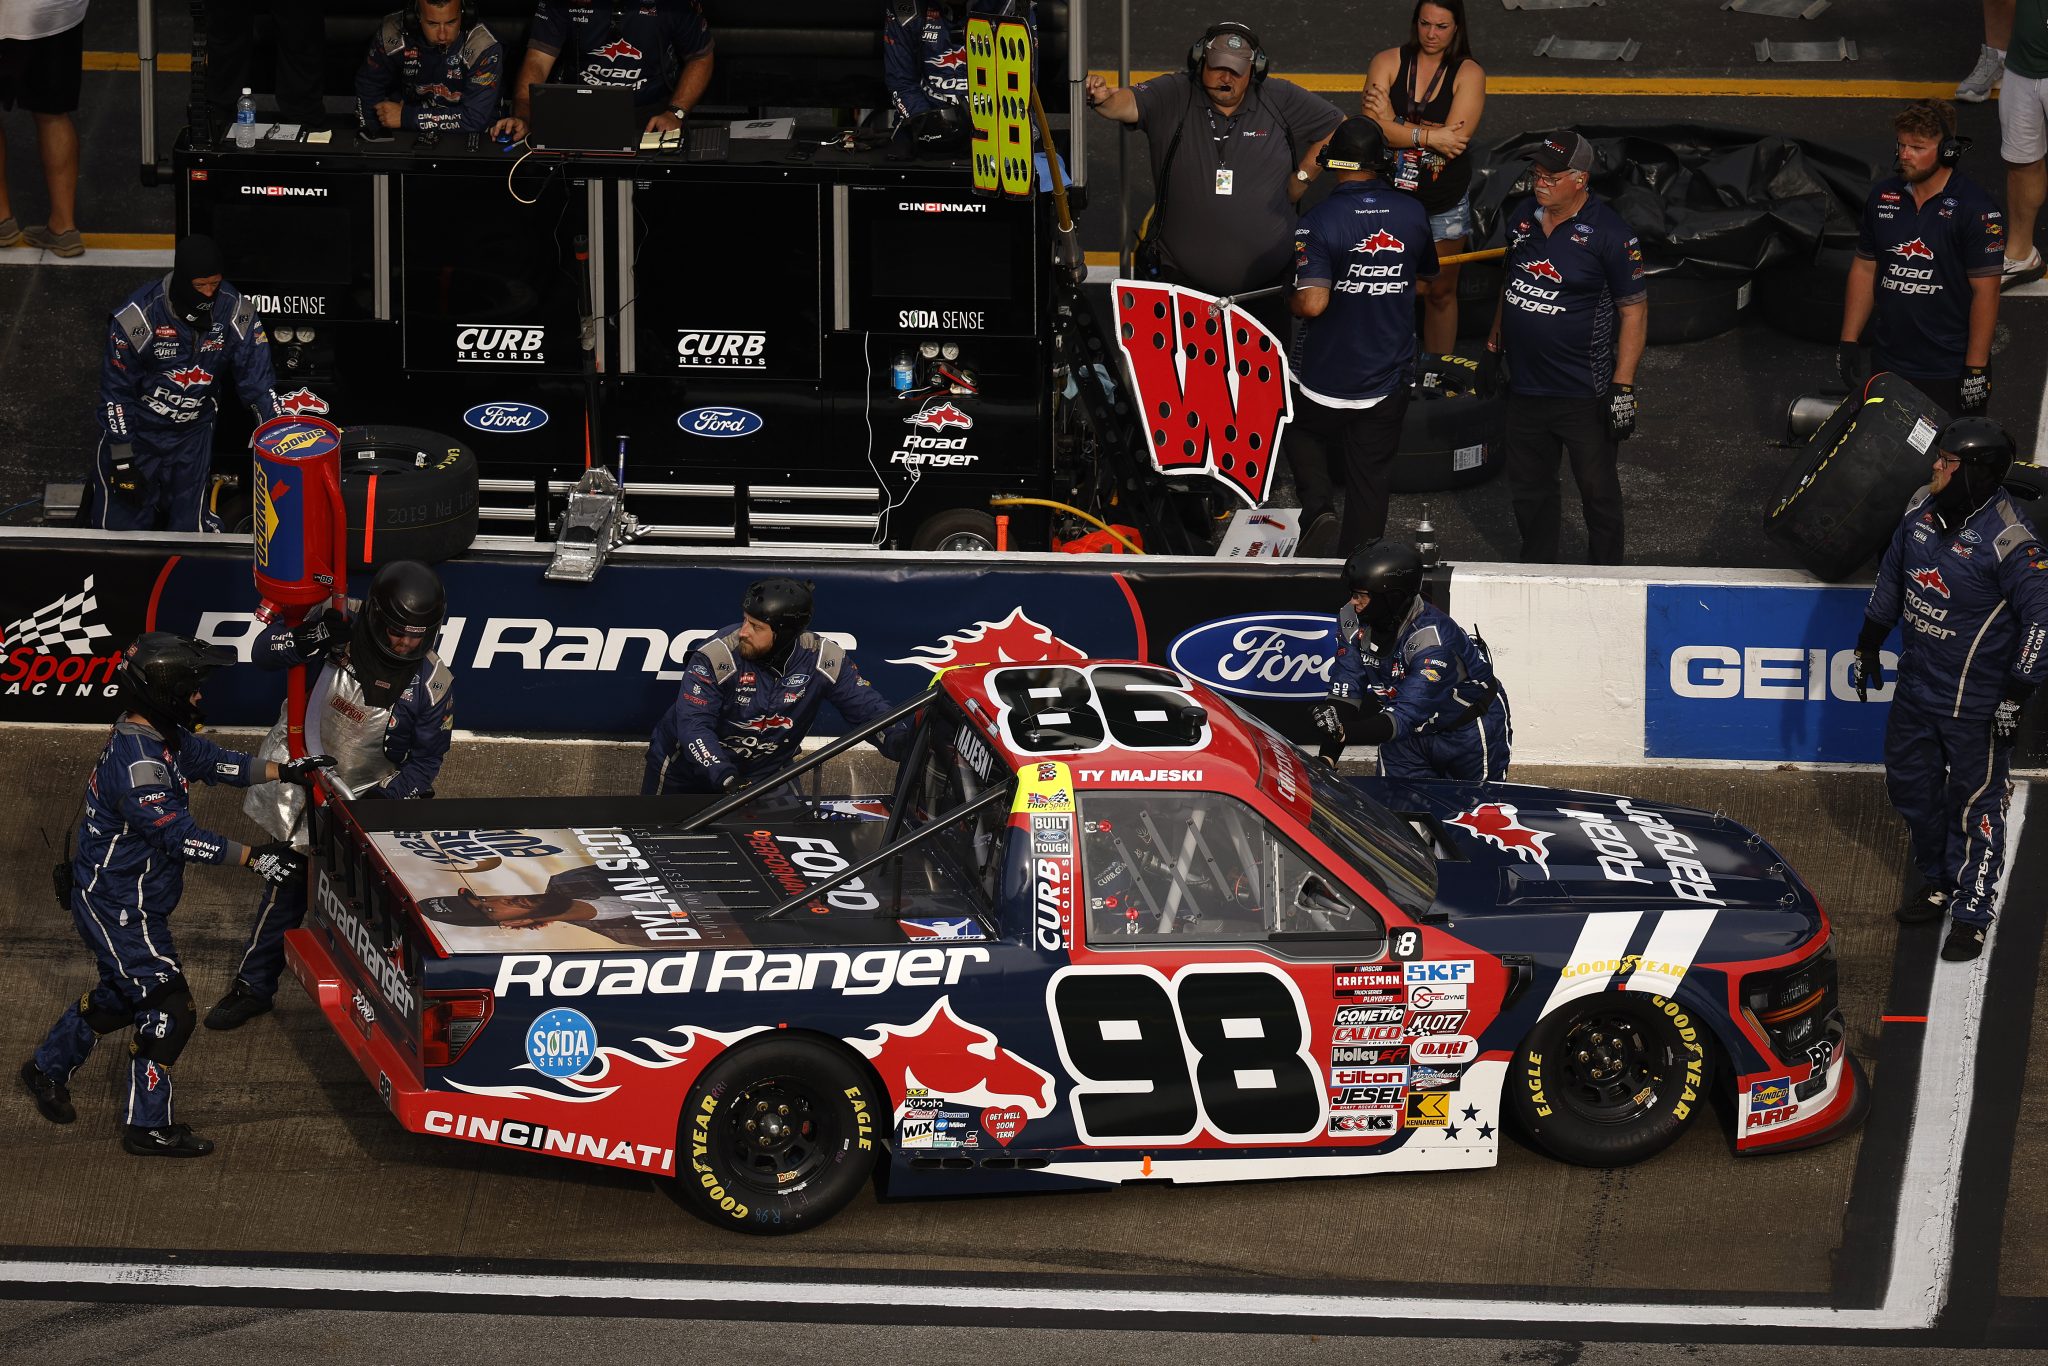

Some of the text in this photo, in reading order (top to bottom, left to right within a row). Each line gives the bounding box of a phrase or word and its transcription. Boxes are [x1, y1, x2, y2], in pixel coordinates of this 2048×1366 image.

[586, 64, 642, 80] Road
[966, 17, 1033, 196] 98
[240, 185, 328, 197] CINCINNATI
[898, 202, 986, 213] CINCINNATI
[1347, 264, 1404, 277] Road
[1888, 263, 1934, 280] Road
[1333, 279, 1409, 296] Ranger
[1511, 278, 1560, 300] Road
[1881, 276, 1944, 295] Ranger
[283, 296, 326, 315] SENSE
[1505, 289, 1567, 316] Ranger
[898, 310, 985, 330] SODA SENSE
[456, 328, 544, 352] CURB
[677, 333, 767, 357] CURB
[458, 351, 545, 360] RECORDS
[679, 357, 767, 366] RECORDS
[480, 405, 531, 428] Ford
[694, 410, 746, 433] Ford
[273, 429, 323, 456] SUNOCO
[902, 434, 967, 450] Road
[890, 450, 979, 467] Ranger
[1905, 587, 1949, 622] Road
[2023, 629, 2047, 675] CURB.COM
[0, 647, 122, 691] Sport
[1669, 645, 1899, 702] GEIC
[3, 682, 120, 698] ACING
[333, 697, 366, 723] SIMPSON
[1078, 769, 1203, 782] TY MAJESKI
[1035, 817, 1069, 830] BUILT
[1035, 842, 1069, 853] TOUGH
[1556, 806, 1654, 885] Road
[1615, 799, 1727, 907] Ranger
[607, 876, 702, 941] DYLAN
[1037, 858, 1061, 951] CURB
[1061, 859, 1070, 949] RECORDS
[316, 868, 415, 1019] Road Ranger
[493, 946, 991, 998] Road Ranger
[1406, 963, 1471, 982] SKF
[1561, 957, 1688, 979] GOODYEAR
[1336, 975, 1400, 987] CRAFTSMAN
[1362, 995, 1394, 1003] PLAYOFFS
[1336, 1008, 1404, 1022] COMETIC
[1411, 1014, 1463, 1030] KLOTZ
[532, 1026, 590, 1059] SODA
[1333, 1026, 1402, 1041] CALICO
[538, 1056, 582, 1068] SENSE
[1046, 962, 1330, 1147] 98
[1333, 1047, 1409, 1065] Holley EFI
[1652, 994, 1704, 1121] GOODYEAR
[1335, 1070, 1403, 1084] tilton
[1527, 1050, 1553, 1118] EAGLE
[906, 1098, 943, 1108] Kubota
[1332, 1087, 1405, 1105] JESEL
[1752, 1088, 1789, 1102] SUNOCO
[843, 1085, 874, 1152] EAGLE
[938, 1111, 970, 1119] Bowman
[989, 1113, 1002, 1121] GET
[1330, 1114, 1394, 1132] KOOKS
[1746, 1104, 1799, 1127] ARP
[904, 1121, 933, 1138] WIX
[996, 1122, 1015, 1130] SOON
[996, 1131, 1015, 1139] TERRI
[423, 1109, 674, 1171] CINCINNATI
[691, 1094, 750, 1220] GOODYEAR
